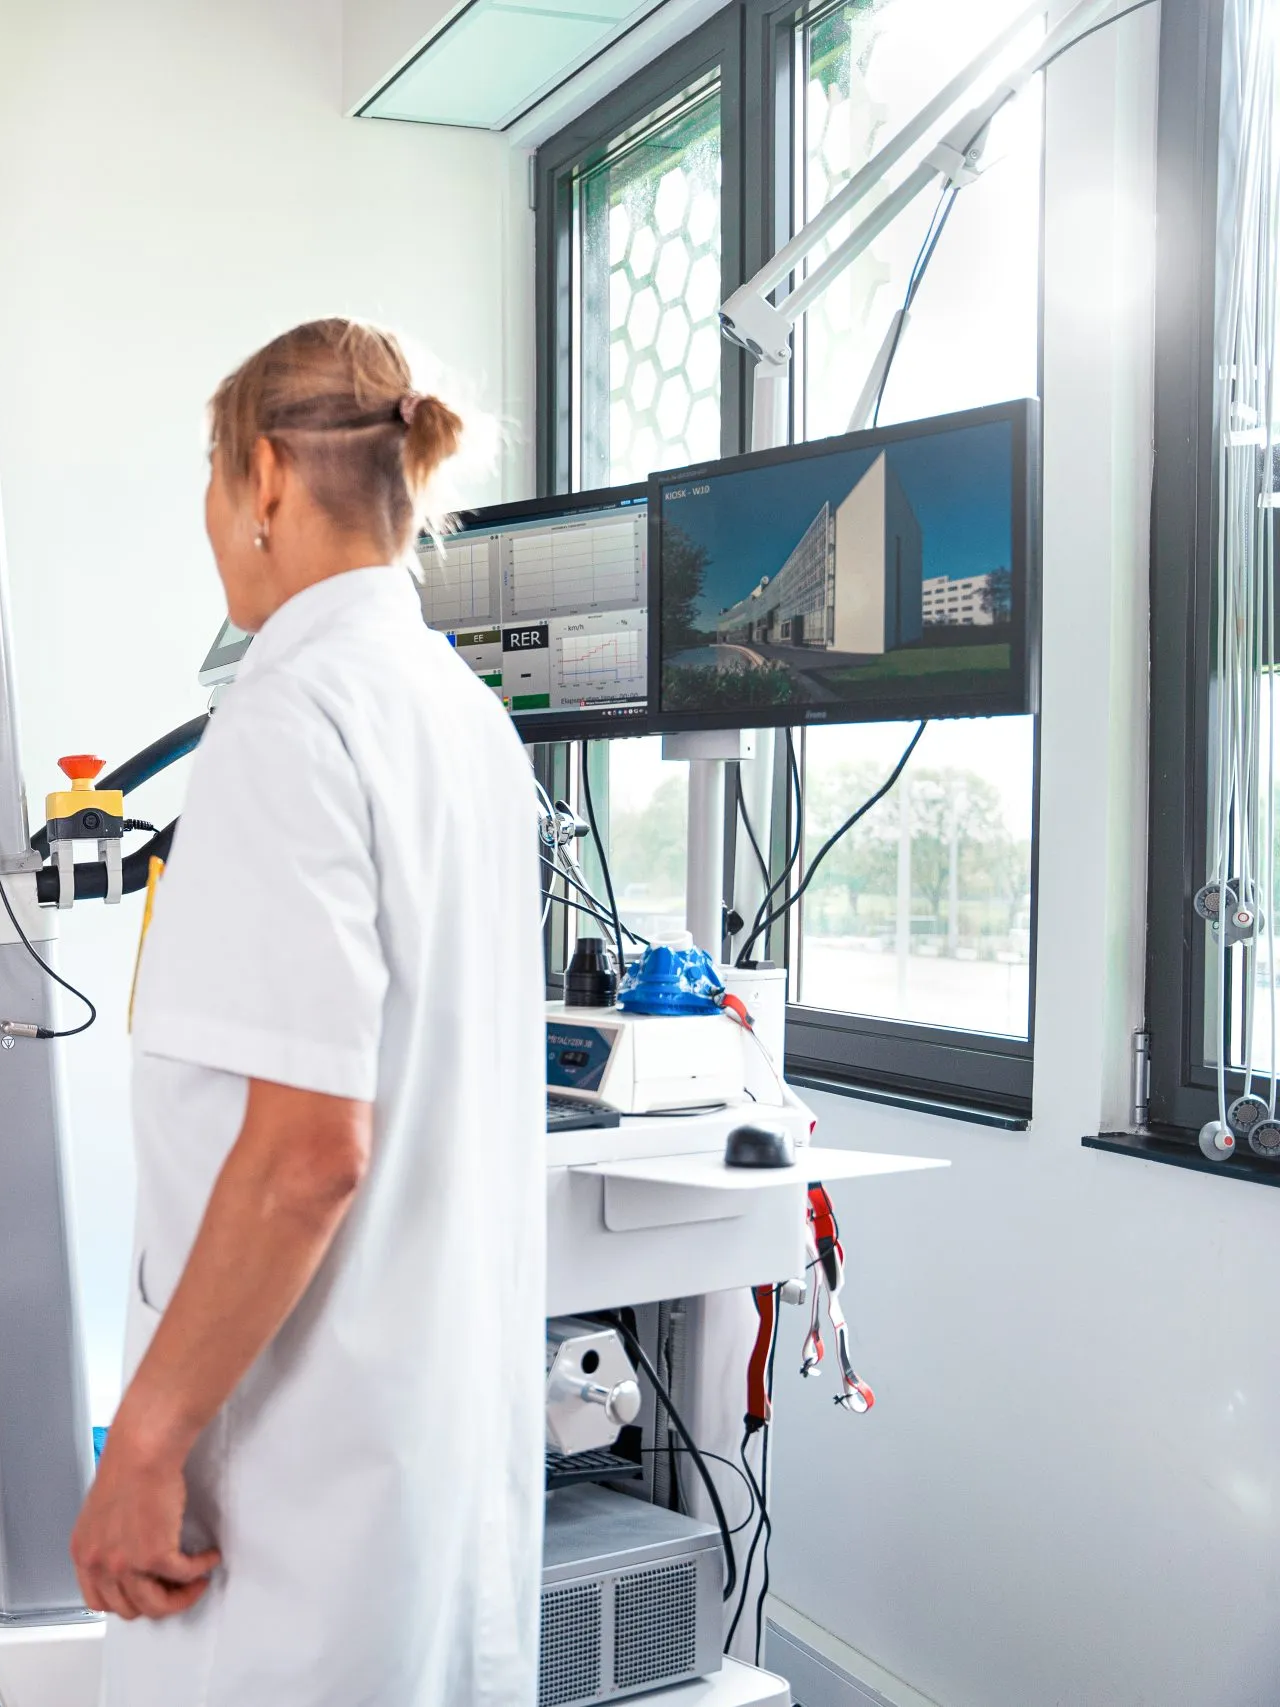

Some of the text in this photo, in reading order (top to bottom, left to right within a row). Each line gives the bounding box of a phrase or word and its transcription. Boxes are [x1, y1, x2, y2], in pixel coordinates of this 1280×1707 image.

[665, 489, 686, 500] KIOSK
[692, 485, 710, 496] W10
[473, 634, 484, 643] EE
[510, 631, 541, 648] RER
